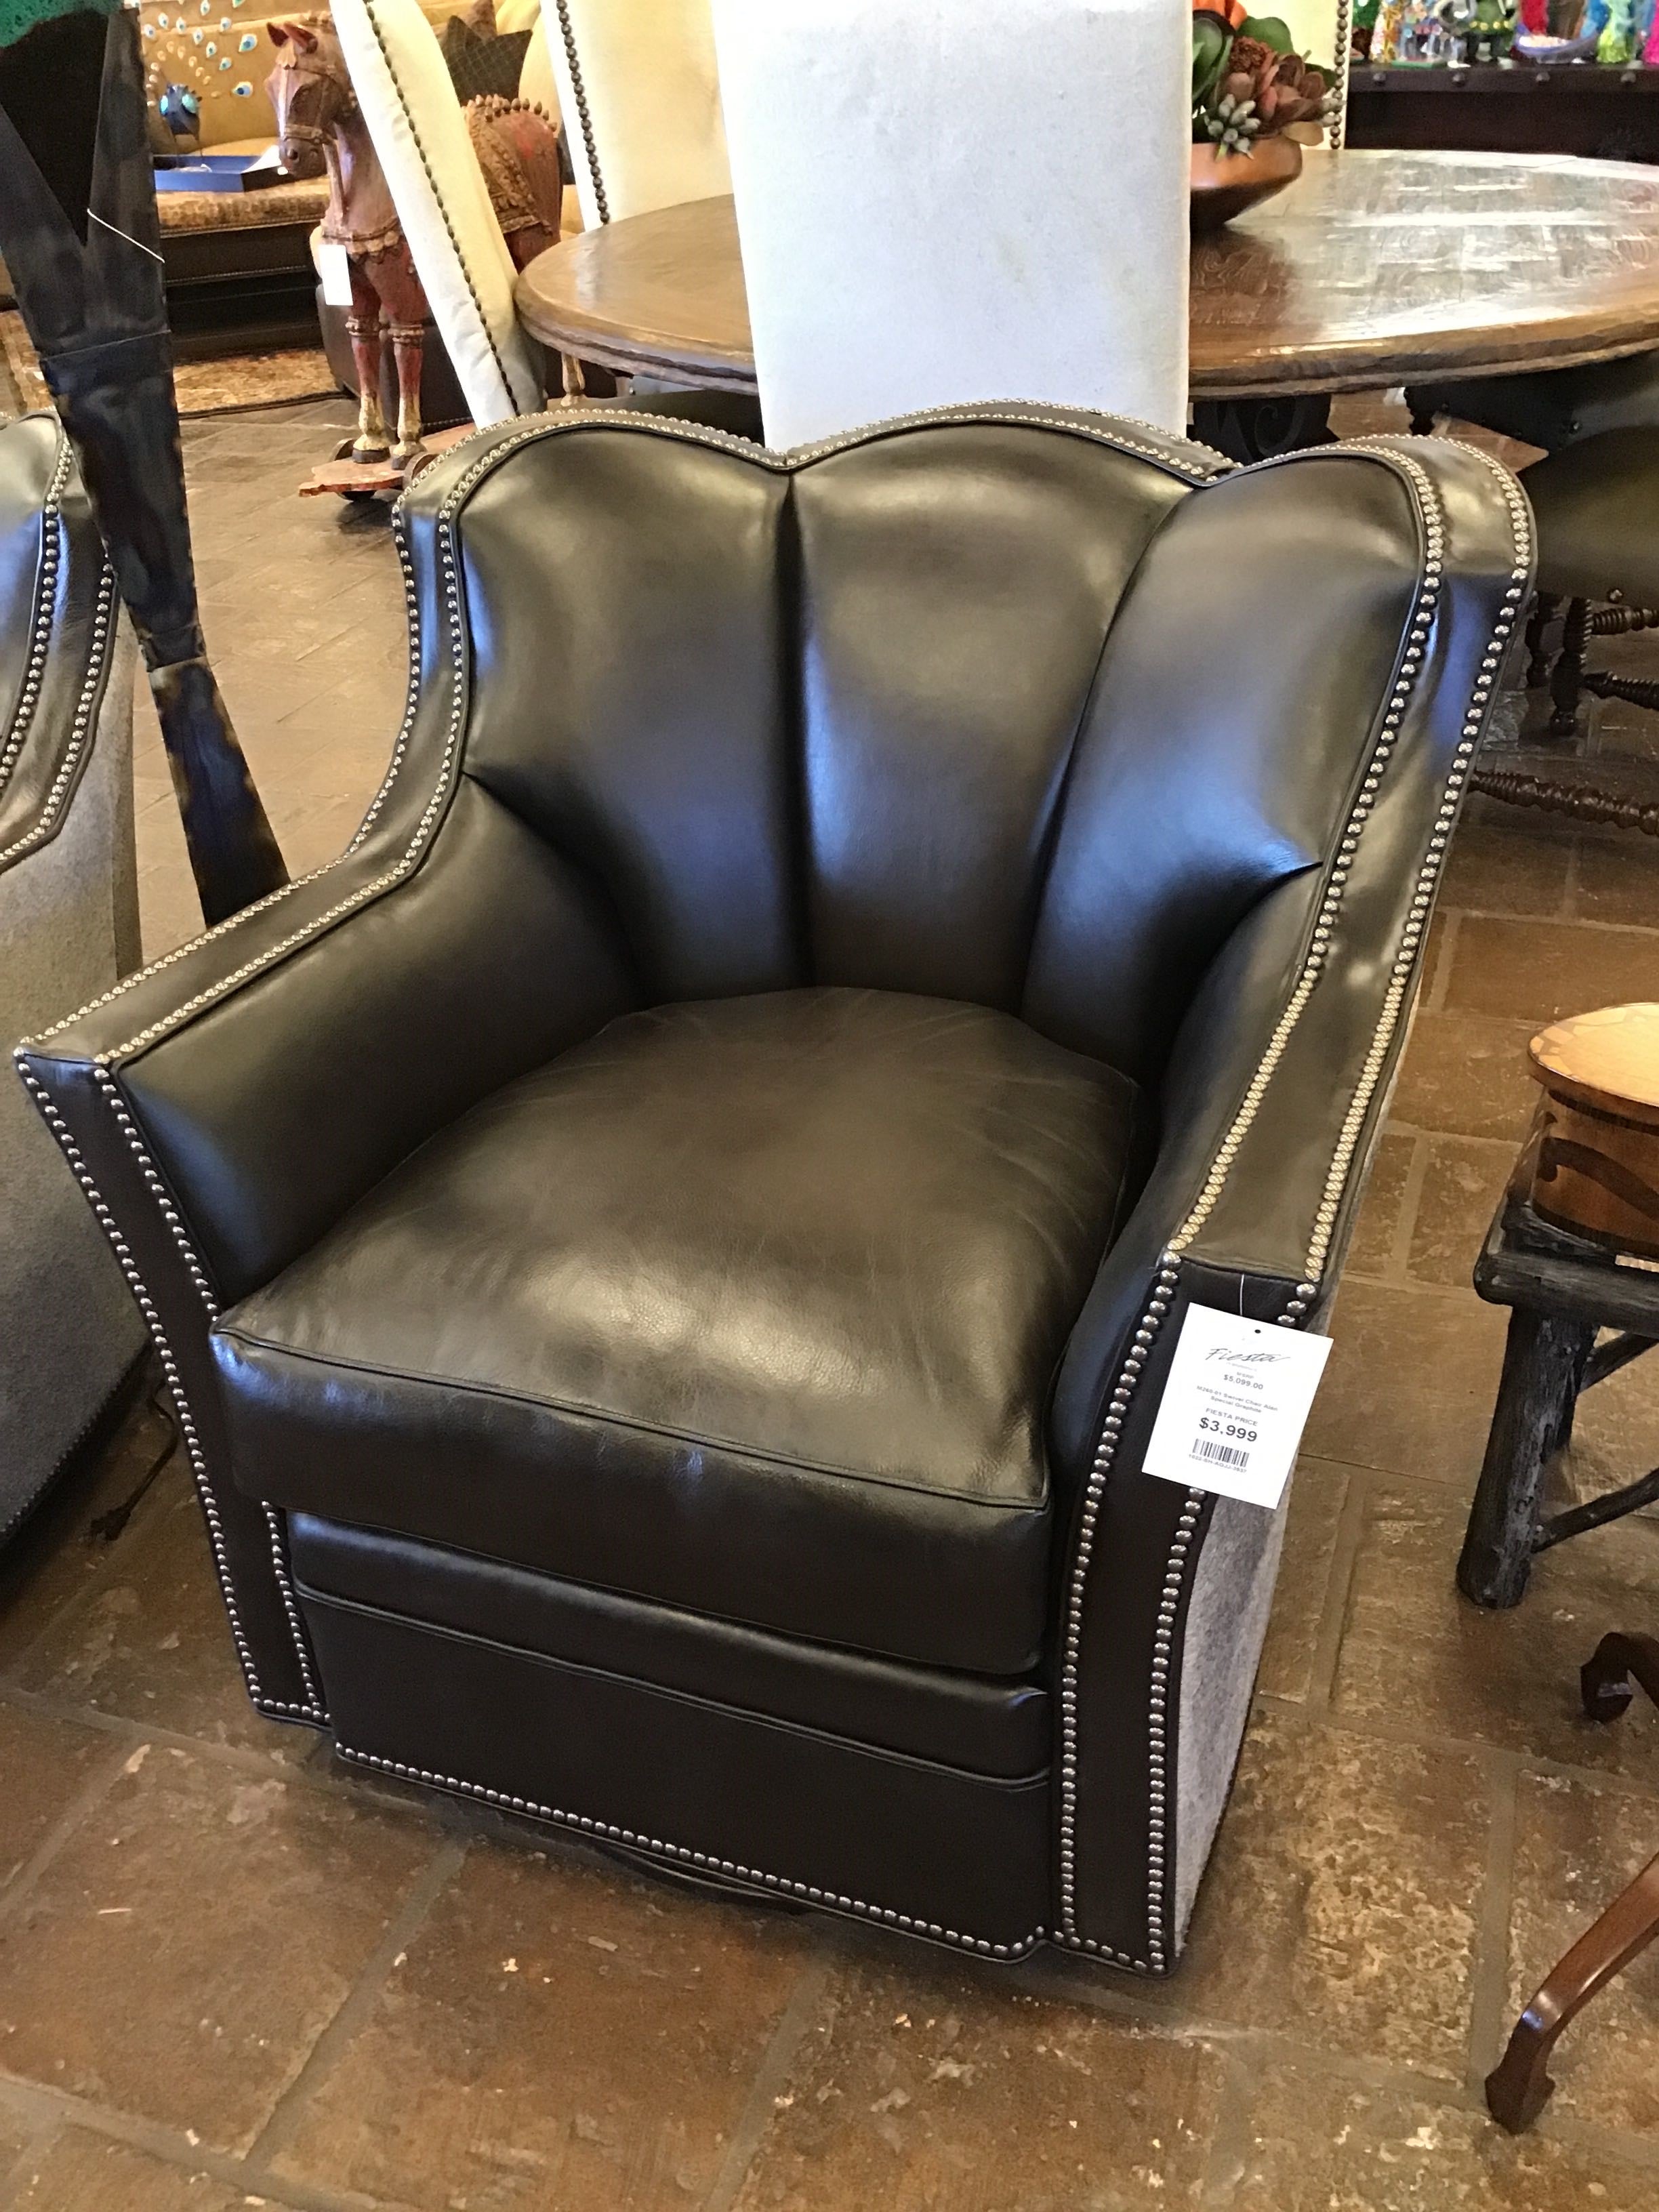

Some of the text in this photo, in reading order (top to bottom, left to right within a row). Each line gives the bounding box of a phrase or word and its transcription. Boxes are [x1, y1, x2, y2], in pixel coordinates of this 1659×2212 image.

[1205, 1348, 1291, 1362] Fiesta
[1206, 1408, 1258, 1427] FIESTA PRICE
